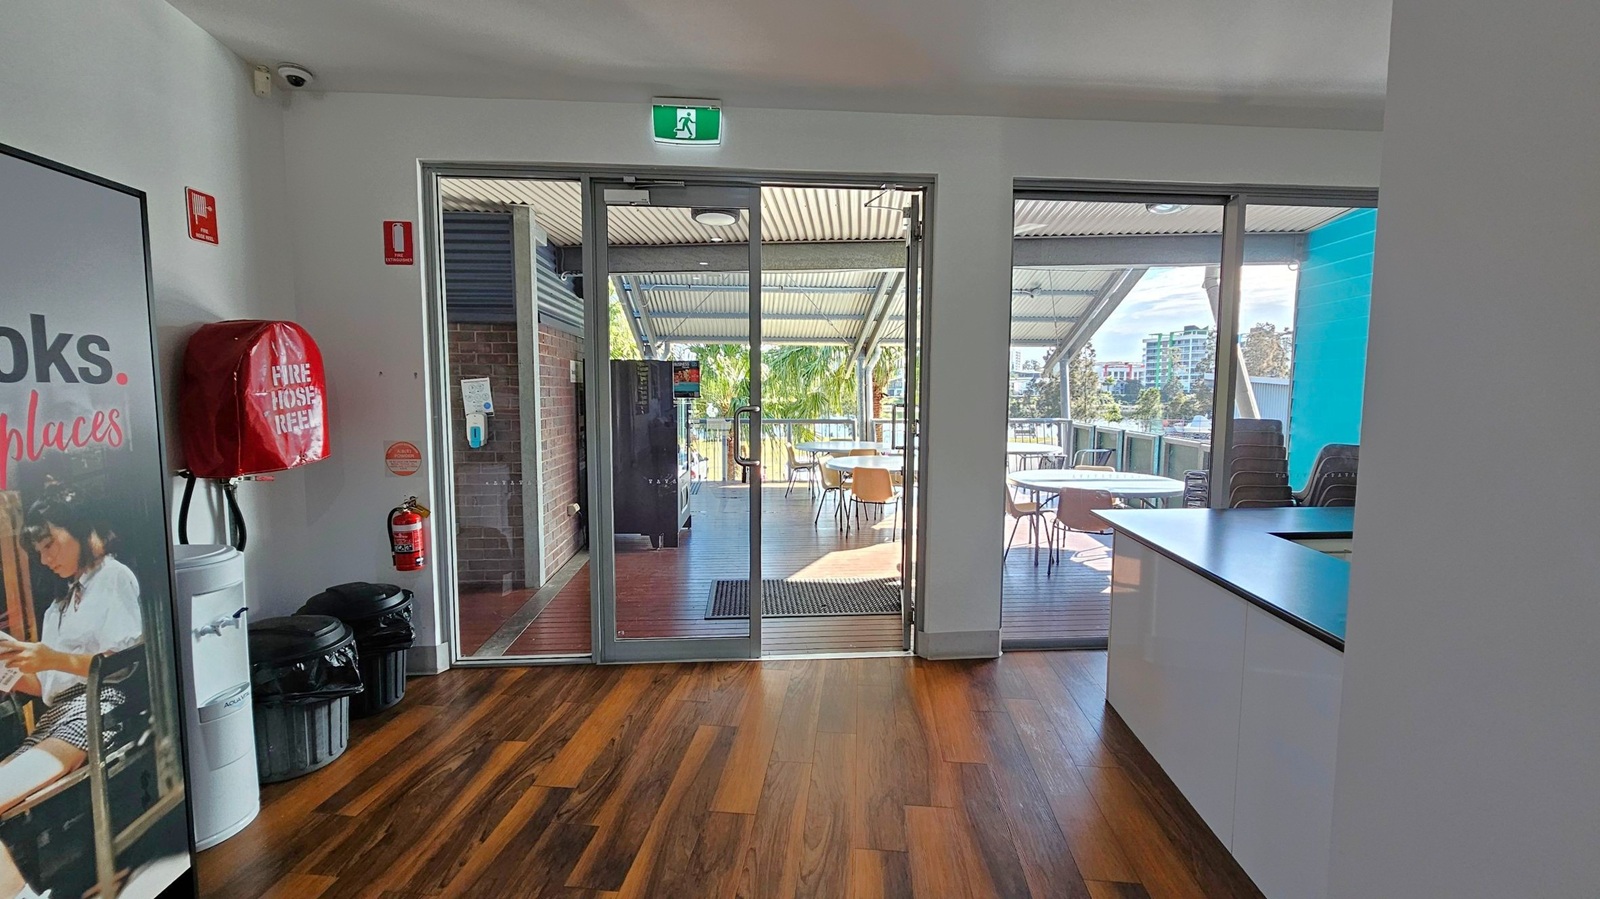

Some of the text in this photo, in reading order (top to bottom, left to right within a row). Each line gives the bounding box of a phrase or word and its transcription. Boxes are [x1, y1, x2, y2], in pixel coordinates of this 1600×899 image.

[271, 363, 312, 386] FIRE
[271, 385, 316, 411] HOSE
[274, 408, 318, 435] REEL
[0, 389, 123, 491] places
[223, 697, 242, 709] AQUA
